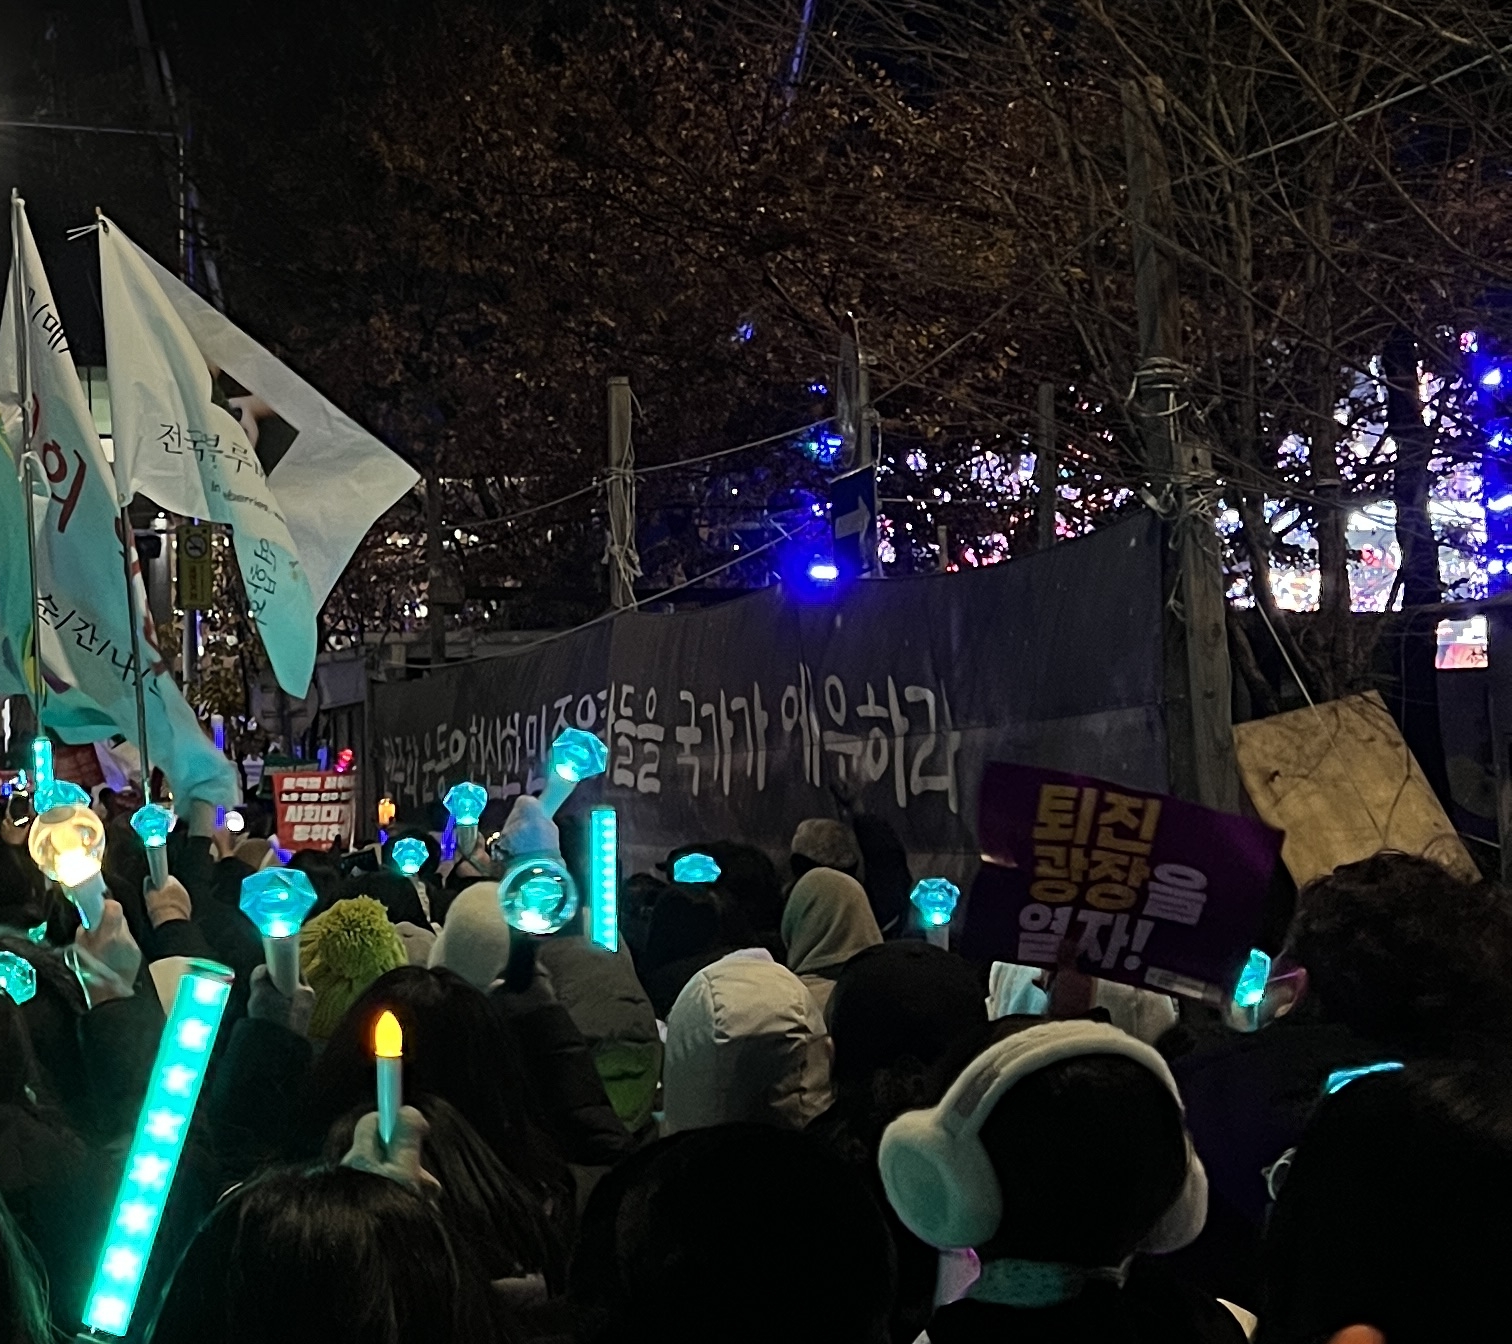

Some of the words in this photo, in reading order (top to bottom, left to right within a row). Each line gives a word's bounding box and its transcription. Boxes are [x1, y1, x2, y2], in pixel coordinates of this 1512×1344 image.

[675, 680, 769, 796] 국가가
[1032, 783, 1163, 856] 퇴진
[1029, 845, 1208, 927] 광장을
[1017, 902, 1156, 971] 열자!
